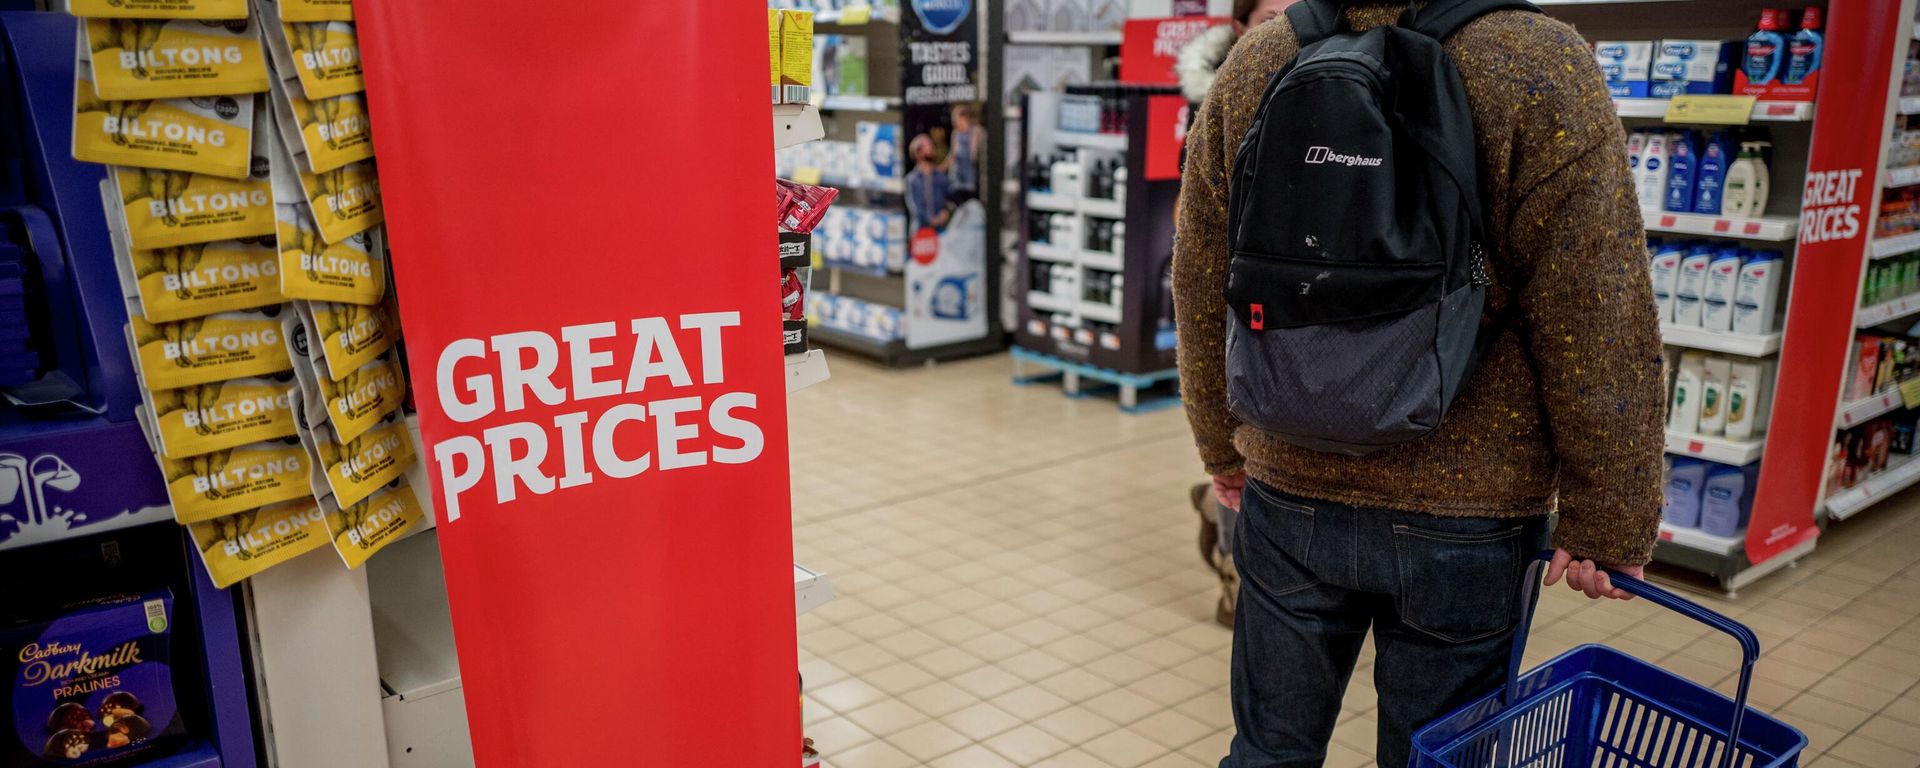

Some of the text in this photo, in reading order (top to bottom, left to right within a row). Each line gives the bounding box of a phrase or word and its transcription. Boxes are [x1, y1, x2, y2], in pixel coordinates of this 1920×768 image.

[119, 46, 242, 70] BILTONG
[303, 47, 358, 70] BILTO
[216, 104, 239, 114] taste
[103, 115, 225, 148] BILTONG
[318, 116, 363, 142] BILTO
[1327, 150, 1382, 166] berghaus
[1802, 168, 1862, 207] GREAT
[148, 190, 267, 218] BILTONG
[163, 260, 276, 292] BILTONG
[301, 254, 372, 278] BILTONG
[163, 329, 278, 360] BILTONG
[436, 311, 740, 422] GREAT
[338, 372, 396, 414] BILTONG
[182, 394, 289, 428] BILTONG
[340, 434, 400, 478] BILTONG
[434, 392, 765, 524] PRICES
[192, 456, 300, 494] BILTONG
[224, 507, 323, 558] BILTONG
[18, 641, 82, 663] Cadbury
[22, 641, 144, 686] Darkmilk
[53, 676, 121, 700] PRALINES
